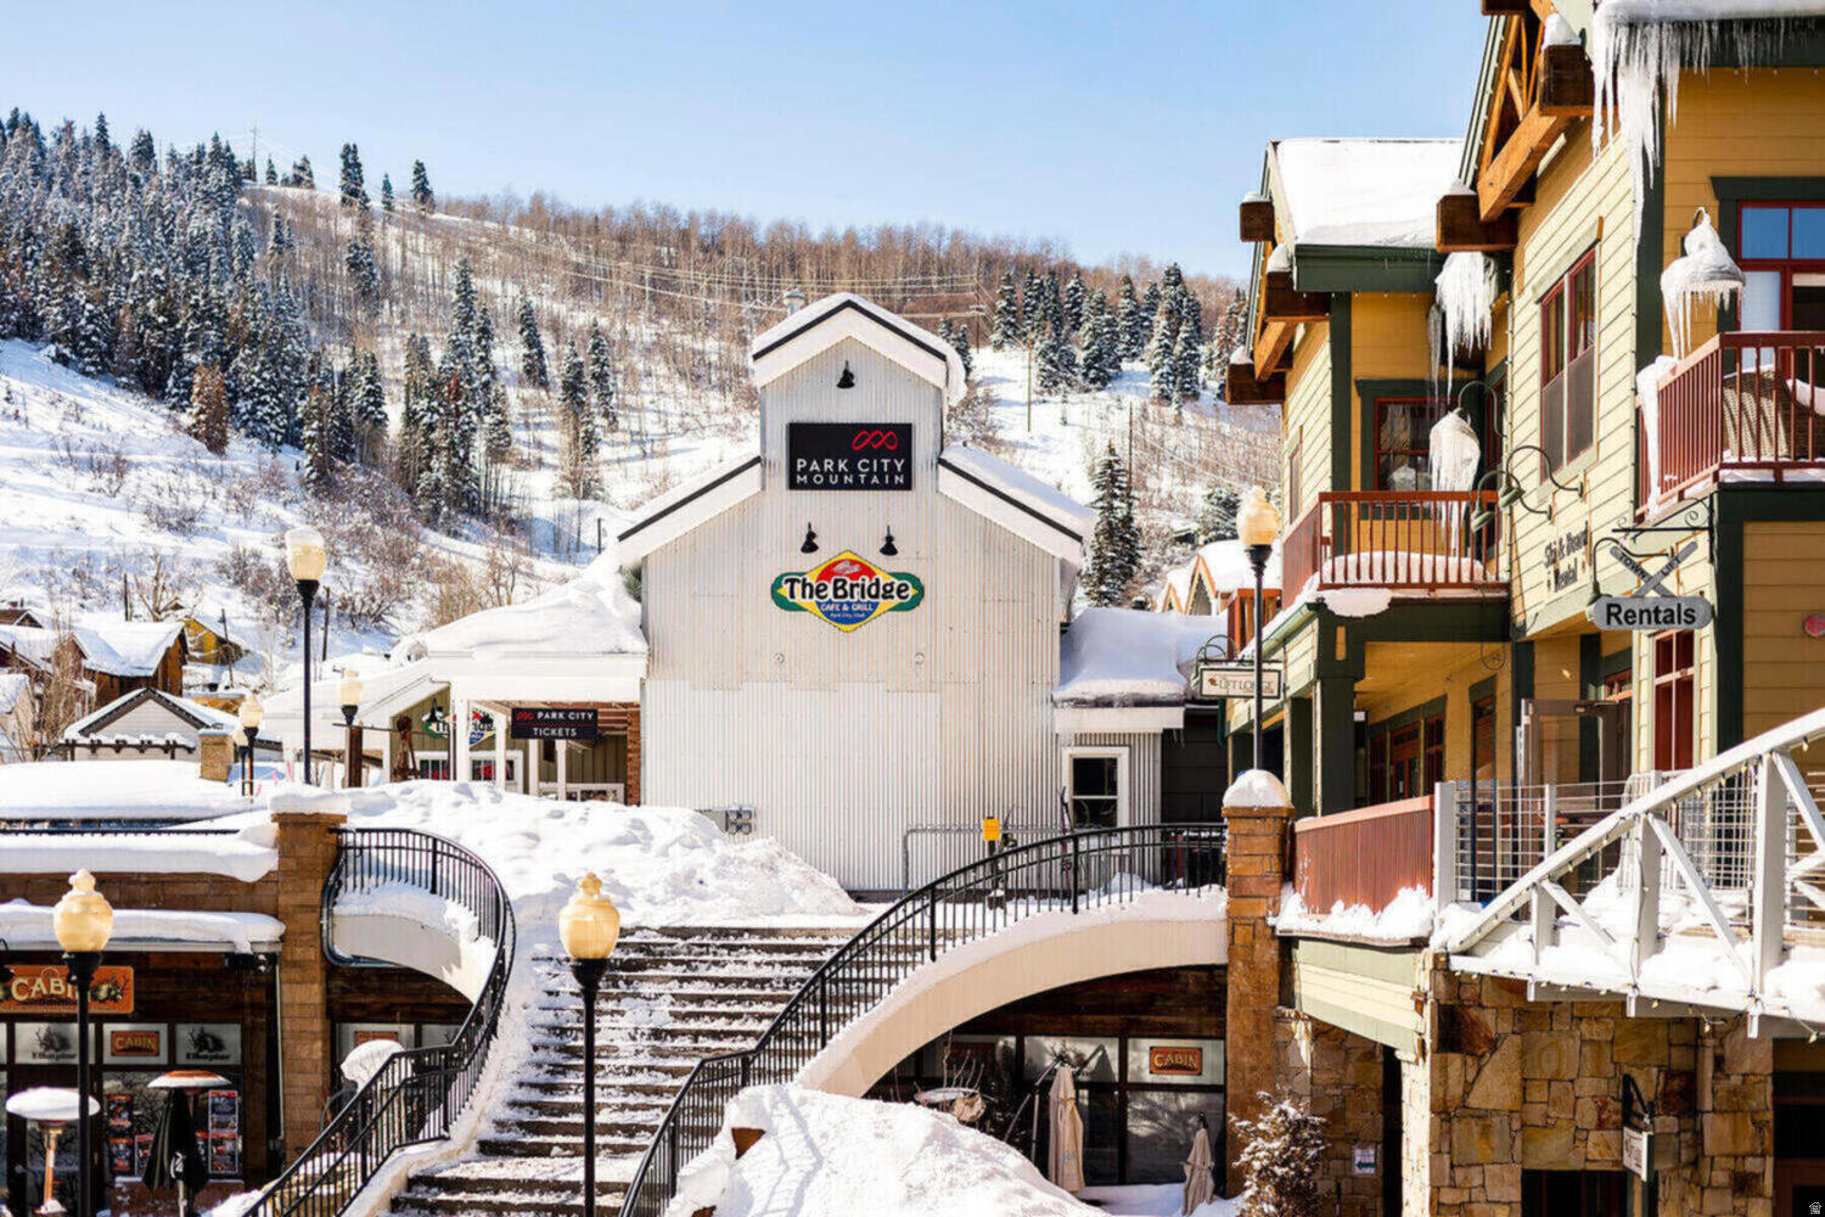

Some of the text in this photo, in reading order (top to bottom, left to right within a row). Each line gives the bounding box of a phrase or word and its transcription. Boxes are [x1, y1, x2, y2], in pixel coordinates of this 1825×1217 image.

[796, 458, 906, 473] PARK CITY
[796, 474, 905, 485] MOUNTAIN
[1620, 551, 1682, 582] TOWN LIFT
[783, 577, 910, 600] The Bridge
[1605, 603, 1697, 626] Rentals
[1239, 679, 1273, 691] LOE
[537, 712, 594, 720] PARK CITY
[533, 727, 578, 737] TICKETS
[11, 977, 91, 1002] CABI
[115, 1036, 157, 1050] CABIN
[1153, 1053, 1198, 1069] CABIN
